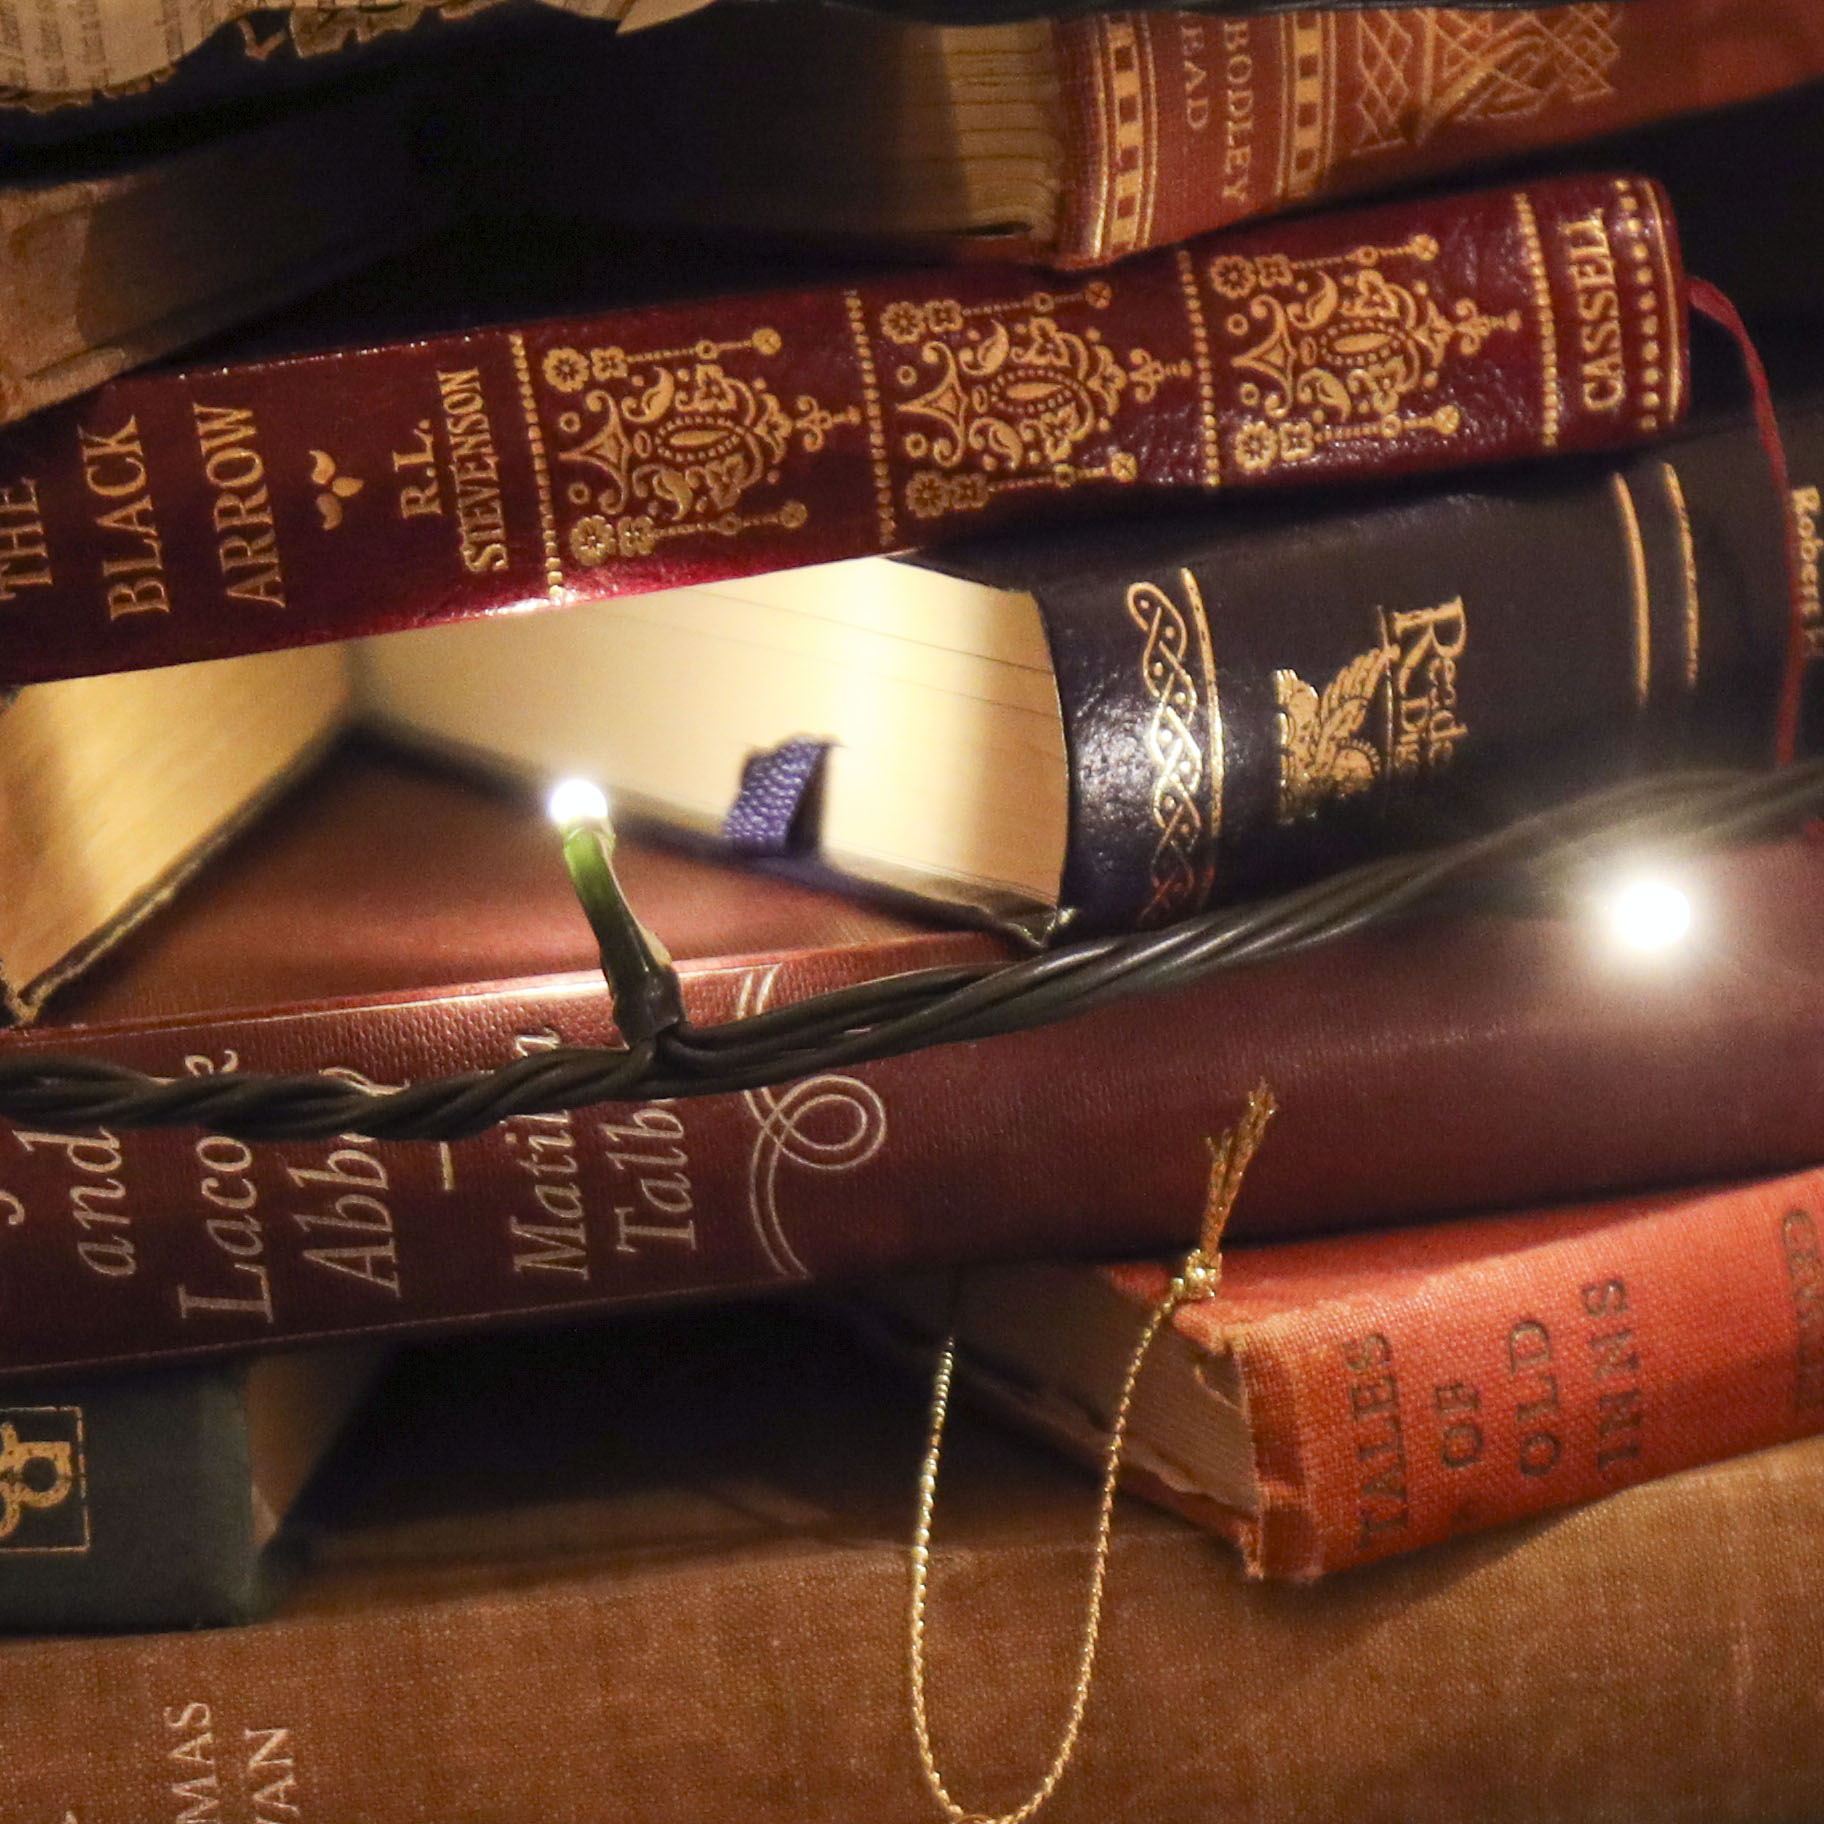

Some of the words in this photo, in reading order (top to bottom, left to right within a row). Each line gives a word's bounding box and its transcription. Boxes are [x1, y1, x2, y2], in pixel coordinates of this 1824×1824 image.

[1559, 208, 1625, 413] CASSELL
[78, 414, 170, 620] BLACK
[193, 400, 287, 608] ARROW
[401, 419, 444, 519] R.L.
[436, 367, 512, 575] STEVENSON
[12, 1125, 140, 1278] and
[1342, 1330, 1409, 1552] TALES
[1433, 1376, 1484, 1471] OF
[1507, 1315, 1559, 1479] OLD
[1581, 1275, 1641, 1471] INNS
